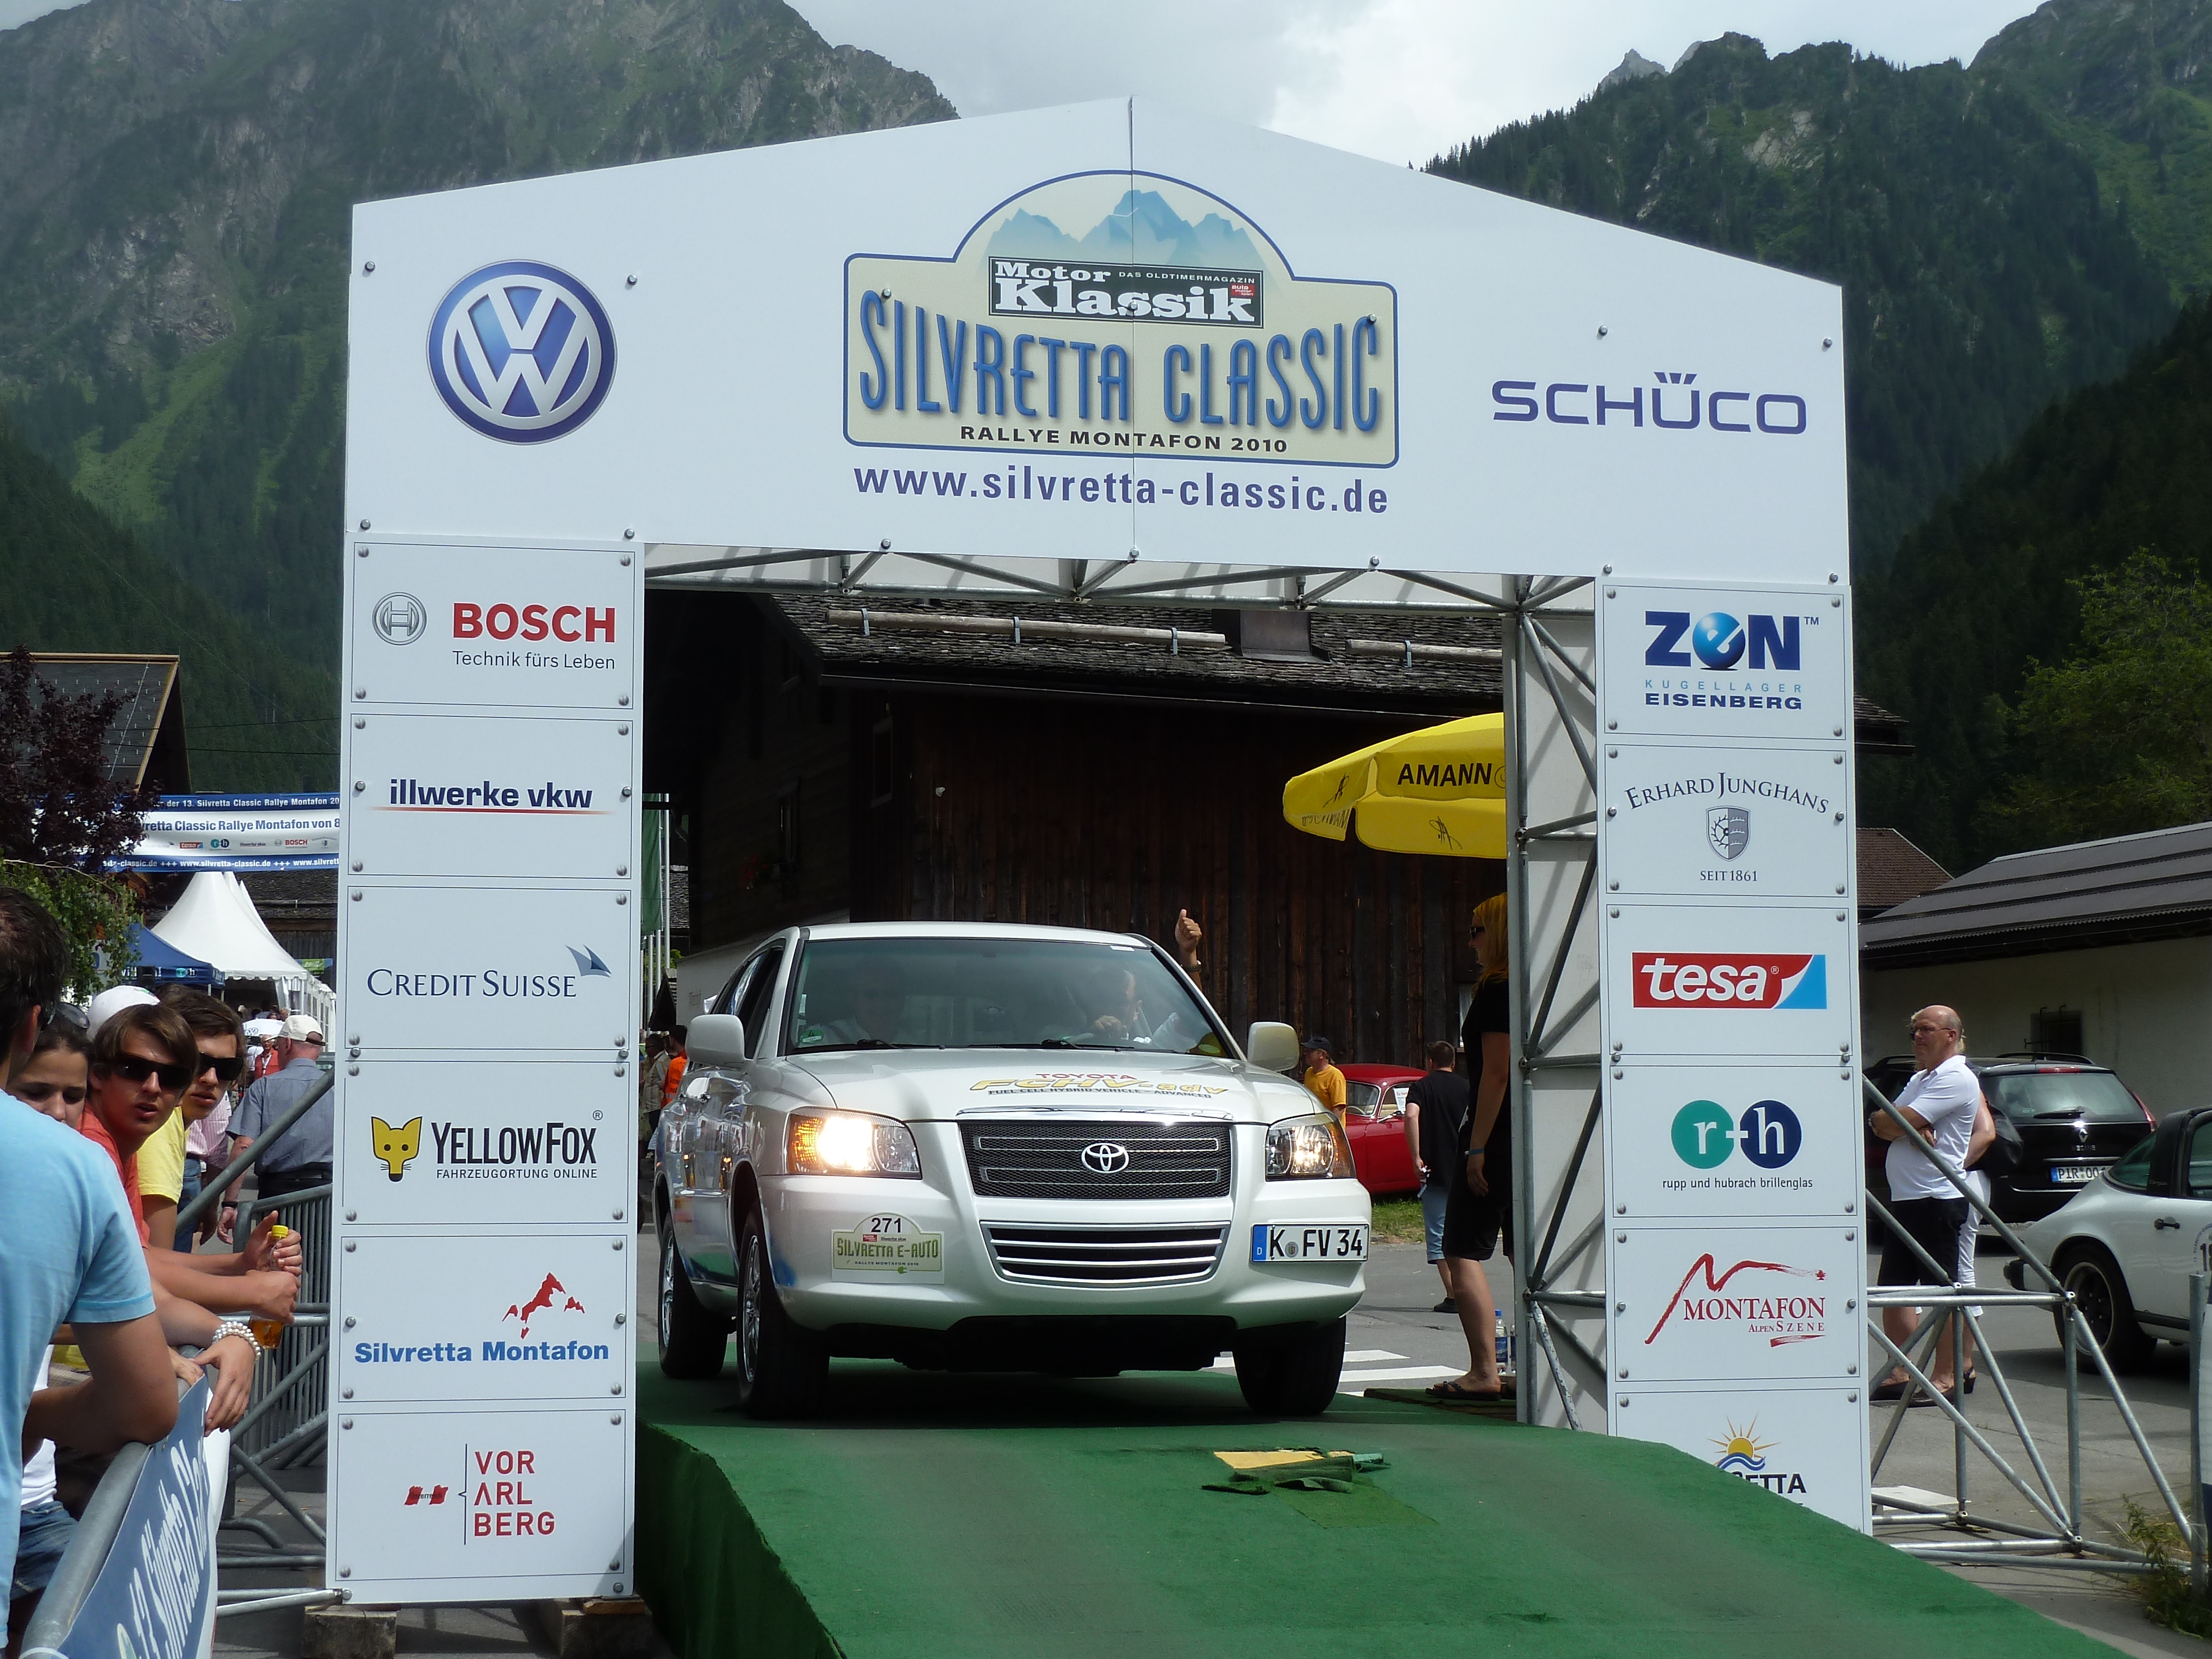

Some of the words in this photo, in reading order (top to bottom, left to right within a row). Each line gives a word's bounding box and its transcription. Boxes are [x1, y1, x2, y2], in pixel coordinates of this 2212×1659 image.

[995, 261, 1111, 283] Motor
[1146, 272, 1255, 284] OLDTIMERMAGAZIN
[995, 278, 1255, 322] Klassik
[859, 290, 1129, 422] SILVRETTA
[1163, 316, 1378, 432] CLASSIC
[1491, 371, 1807, 435] SCHÜCO
[960, 424, 1061, 445] RALLYE
[1070, 430, 1222, 451] MONTAFON
[1230, 437, 1288, 454] 2010
[854, 464, 1389, 515] www.silvretta-classic.de
[452, 602, 616, 643] BOSCH
[452, 650, 520, 667] Technik
[525, 651, 559, 668] fürs
[564, 654, 615, 670] Leben
[1645, 680, 1802, 693] KUGELLAGER
[1645, 692, 1802, 710] EISENBERG
[1397, 762, 1493, 787] AMANN
[197, 799, 231, 807] Silvretta
[233, 798, 262, 807] Classic
[264, 797, 288, 807] Rallye
[291, 797, 328, 806] Montafon
[390, 779, 520, 807] illwerke
[527, 781, 593, 808] vkw
[1624, 778, 1715, 810] ERHARD
[1717, 771, 1829, 813] JUNGHANS
[174, 820, 216, 832] Classic
[218, 820, 254, 833] Rallye
[255, 818, 309, 831] Montafon
[311, 820, 330, 830] von
[180, 859, 271, 868] www.silvretta-classic.de
[1699, 870, 1728, 881] SEIT
[1729, 870, 1758, 882] 1861
[367, 968, 477, 997] CREDIT
[482, 969, 577, 998] SUISSE
[1640, 957, 1768, 1001] tesa
[969, 1078, 1229, 1095] FCHV-adv
[1154, 1089, 1212, 1099] ADVANCED
[436, 1168, 549, 1180] FAHRZEUGORTUNG
[553, 1168, 598, 1179] ONLINE
[1662, 1178, 1687, 1191] rupp
[1690, 1177, 1710, 1189] und
[1714, 1177, 1756, 1189] hubrach
[1760, 1177, 1813, 1191] brillenglas
[2057, 1167, 2079, 1180] PIR
[870, 1217, 902, 1233] 271
[837, 1237, 894, 1258] SILVRETTA
[897, 1239, 938, 1258] E-AUTO
[1269, 1228, 1286, 1257] K
[1302, 1228, 1331, 1257] FV
[1337, 1228, 1363, 1257] 34
[1683, 1297, 1825, 1321] MONTAFON
[354, 1342, 472, 1363] Silvretta
[482, 1340, 609, 1361] Montafon
[474, 1450, 535, 1475] VOR
[1731, 1470, 1807, 1494] ETTA
[473, 1510, 555, 1537] BERG
